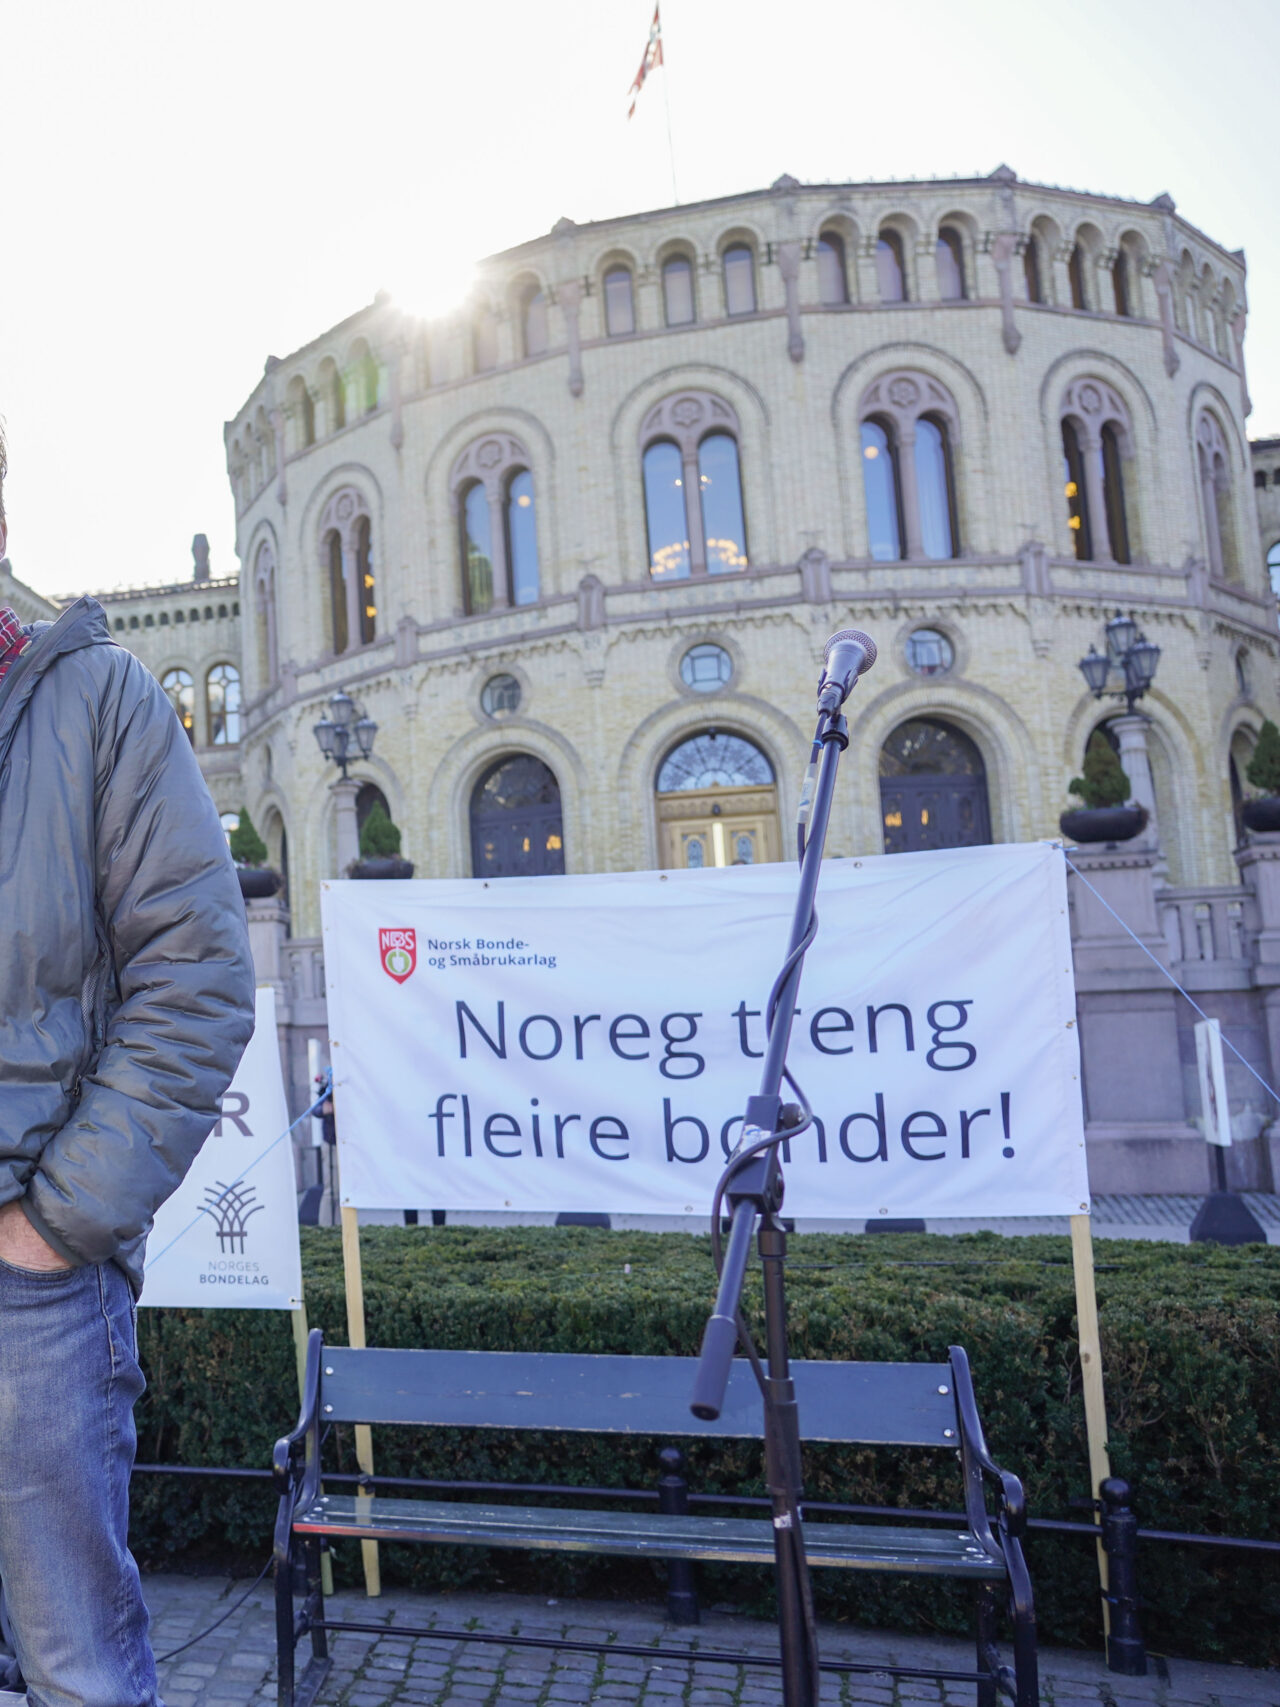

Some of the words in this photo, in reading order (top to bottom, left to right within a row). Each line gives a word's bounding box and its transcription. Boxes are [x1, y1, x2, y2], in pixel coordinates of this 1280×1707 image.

[427, 938, 471, 950] Norsk
[476, 938, 530, 950] Bonde-
[428, 957, 446, 969] og
[450, 954, 557, 969] Småbrukarlag
[455, 1000, 706, 1080] Noreg
[730, 999, 977, 1072] teng
[427, 1093, 630, 1161] fleire
[208, 1260, 260, 1272] NORGES
[199, 1273, 270, 1286] BONDELAG
